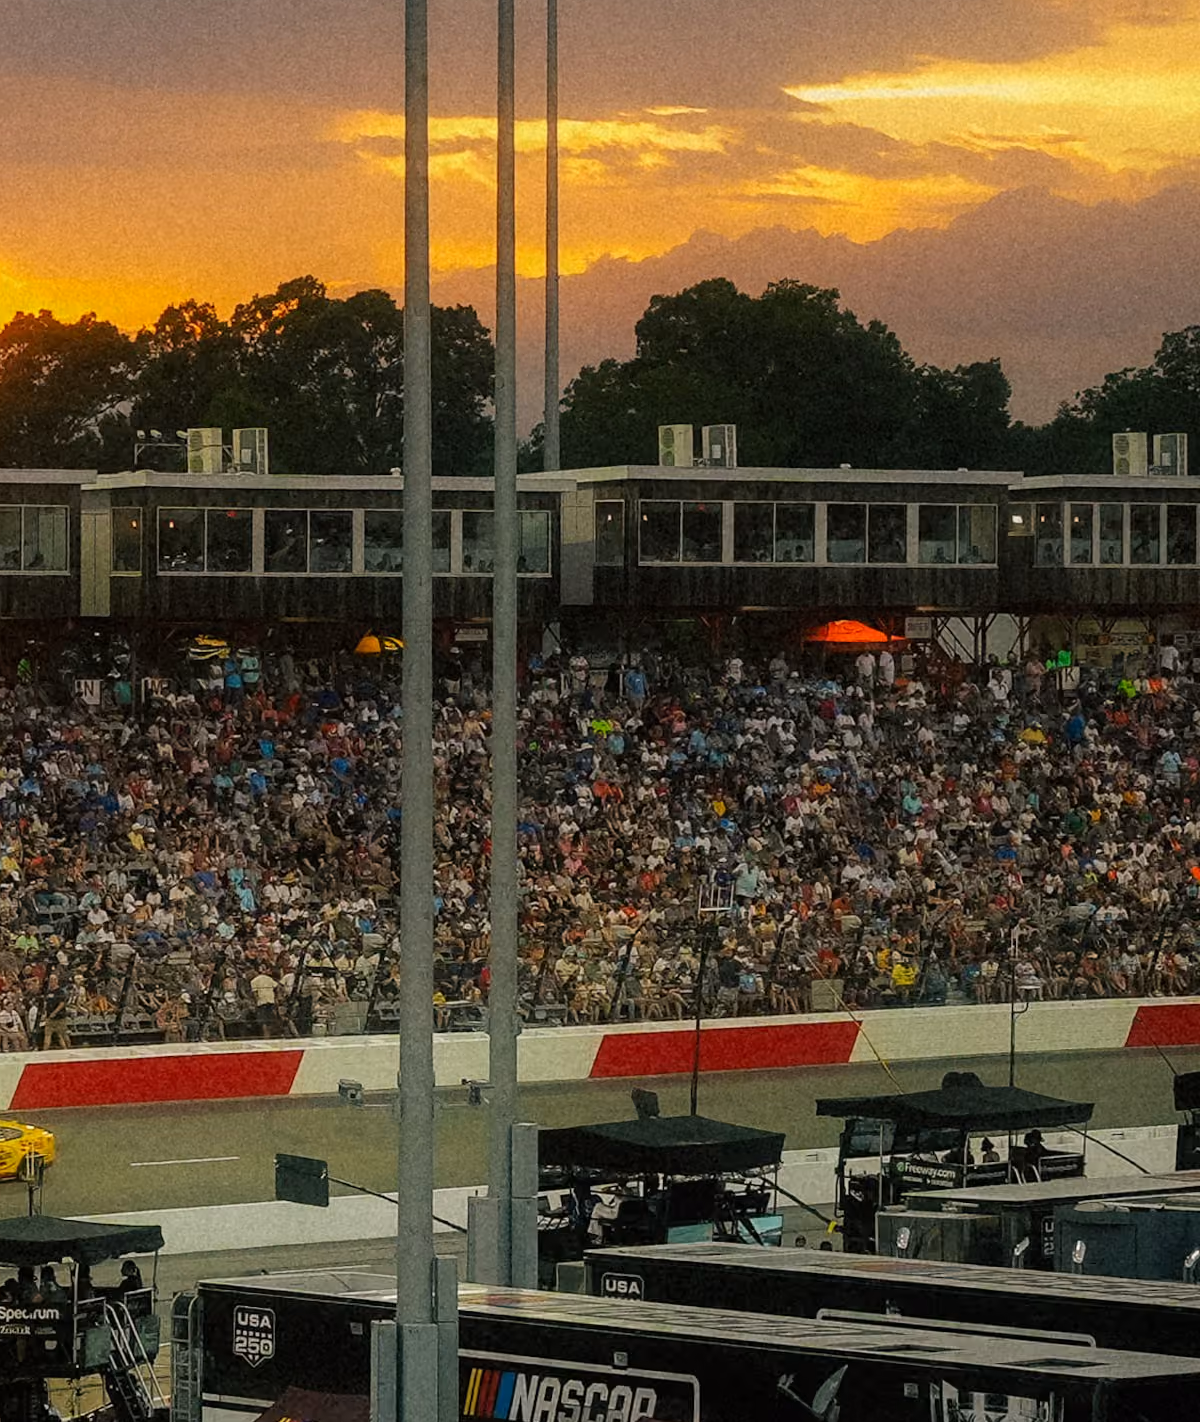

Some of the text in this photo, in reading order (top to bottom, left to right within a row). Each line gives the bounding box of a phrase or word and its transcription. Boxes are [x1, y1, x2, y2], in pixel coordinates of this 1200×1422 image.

[606, 1278, 640, 1293] USA
[237, 1312, 271, 1328] USA
[235, 1338, 273, 1355] 250
